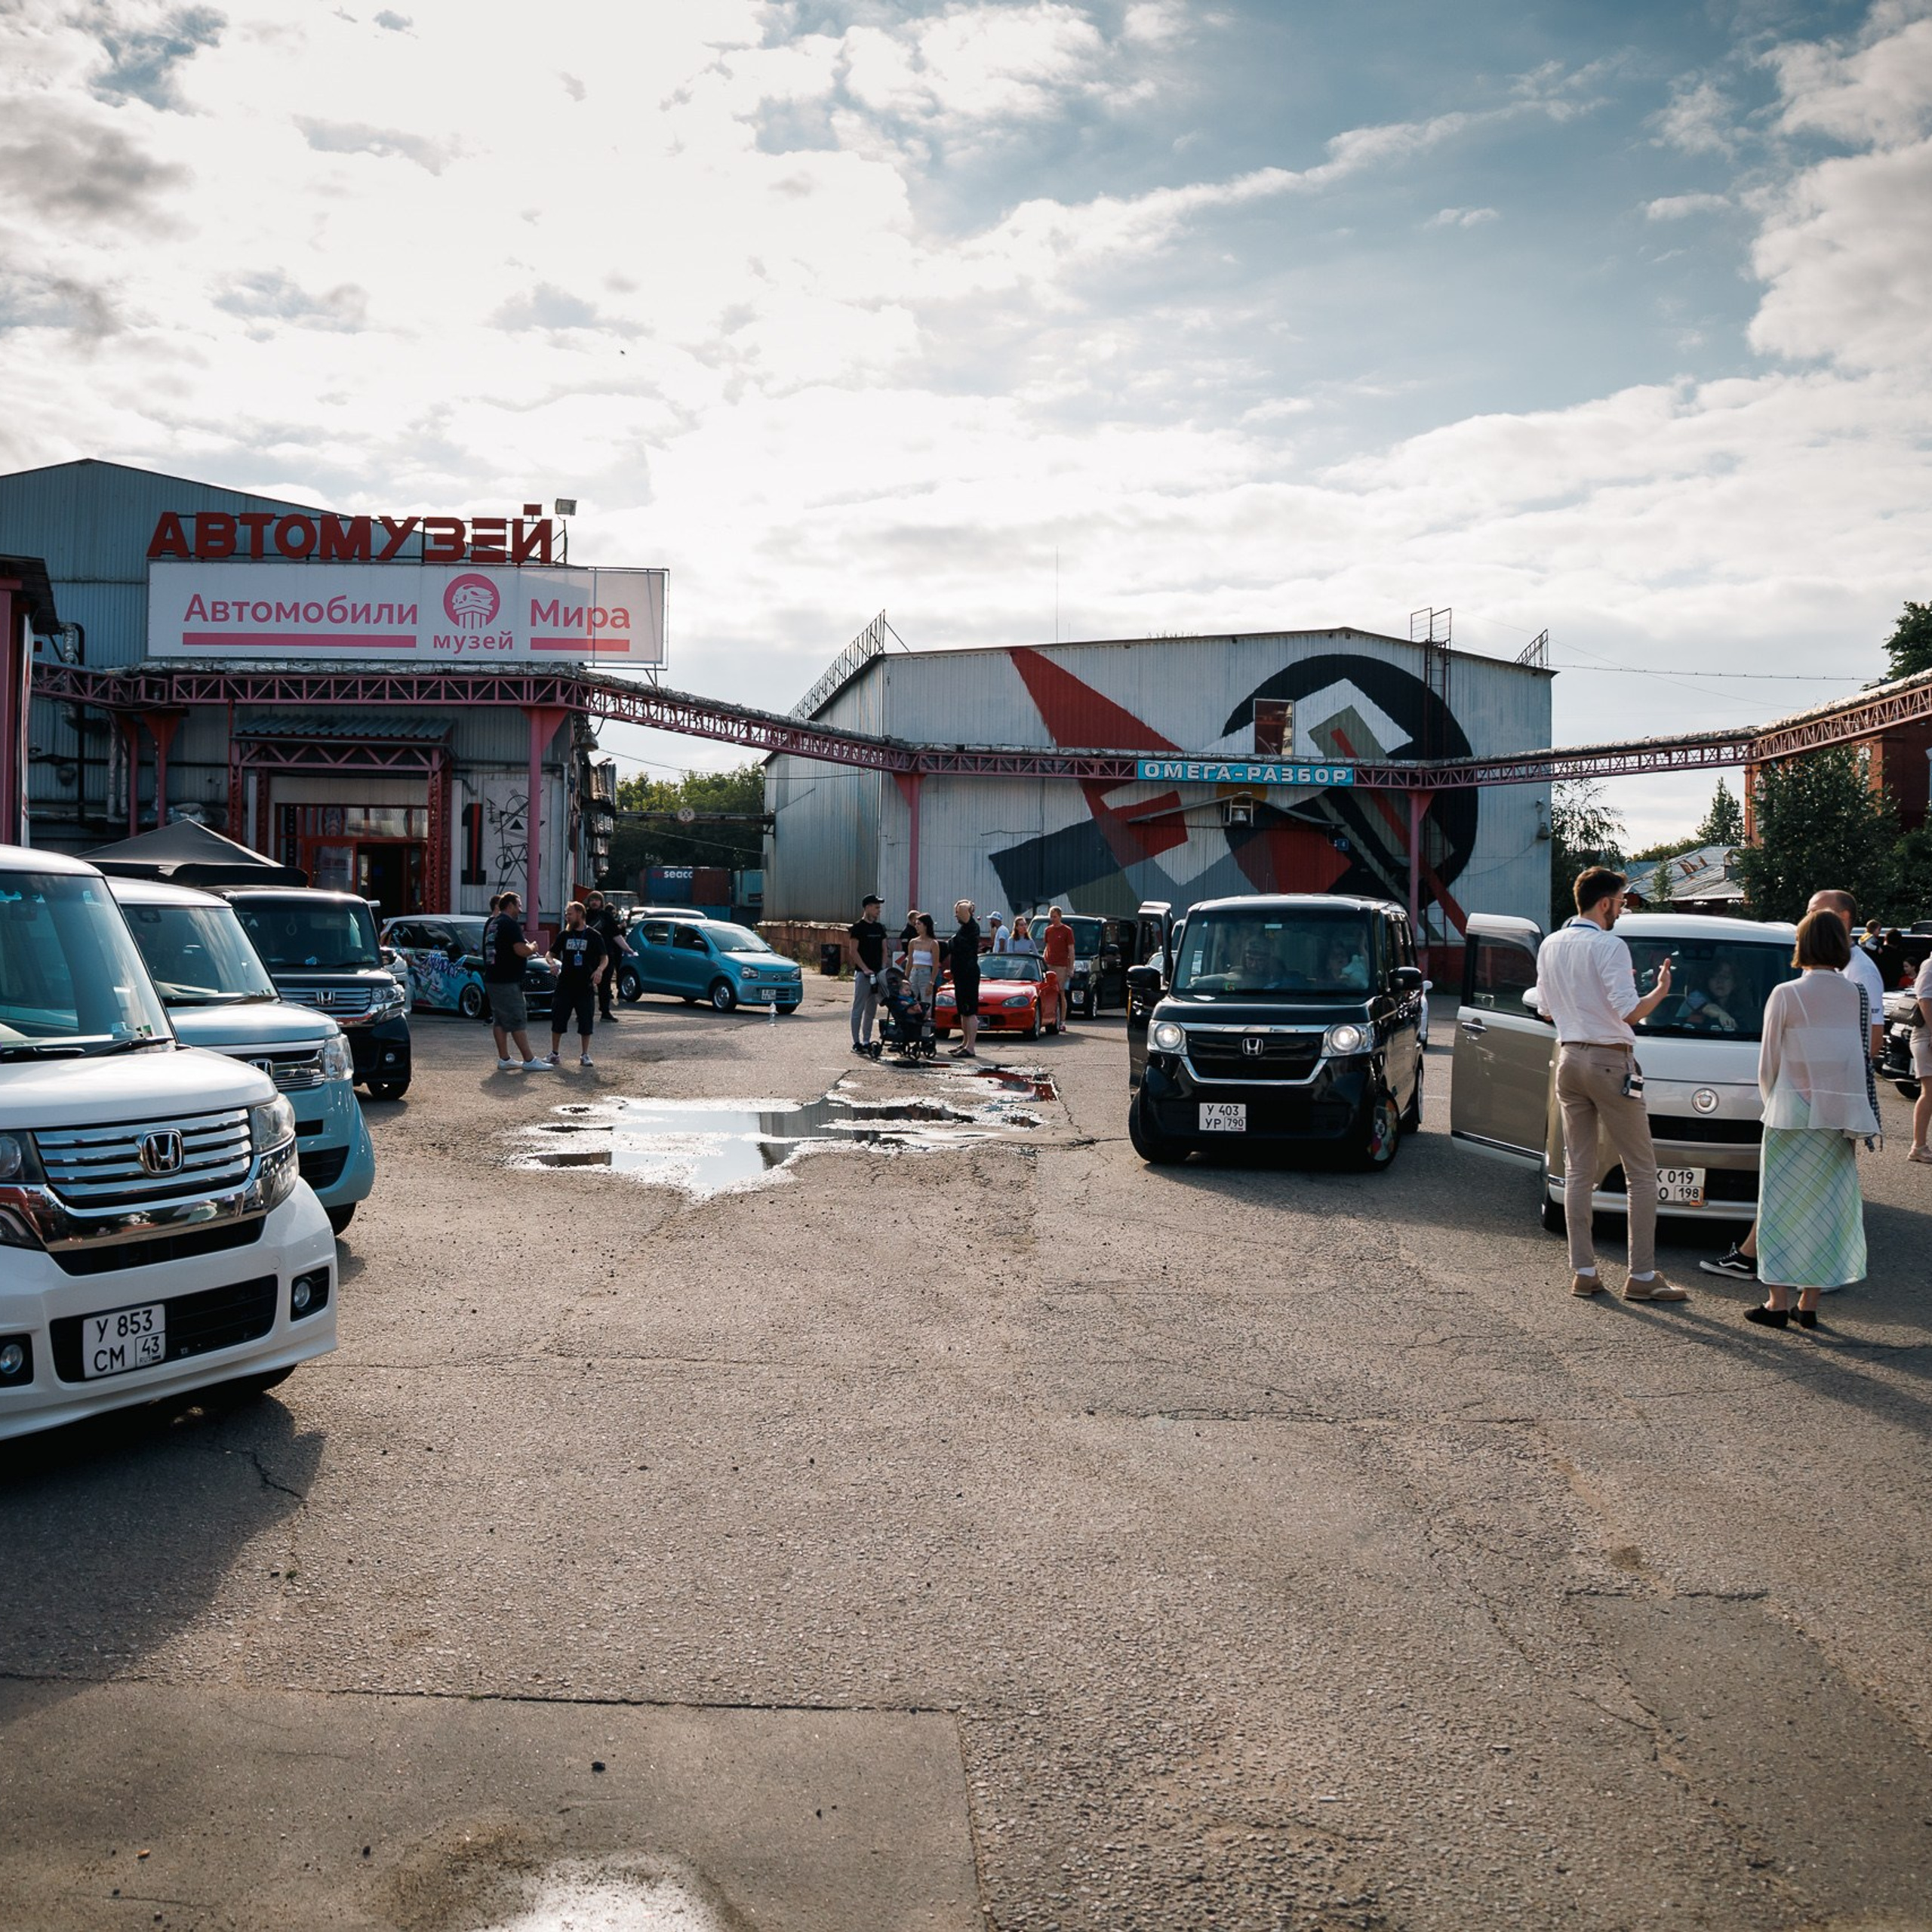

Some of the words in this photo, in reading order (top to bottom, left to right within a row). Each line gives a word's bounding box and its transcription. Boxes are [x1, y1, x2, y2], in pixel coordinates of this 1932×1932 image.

[146, 504, 552, 565] АВТОМУЗЕЙ
[183, 593, 418, 626] Автомобили
[531, 598, 631, 636] Мира
[433, 630, 513, 654] музей
[1144, 761, 1348, 784] ОМЕГА-РАЗБОР
[1219, 1105, 1238, 1115] 403
[1205, 1118, 1221, 1130] УР
[1227, 1118, 1244, 1127] 790
[1667, 1170, 1694, 1185] 019
[1678, 1187, 1700, 1198] 198
[118, 1309, 152, 1337] 853
[142, 1336, 160, 1355] 43
[94, 1344, 125, 1372] СМ
